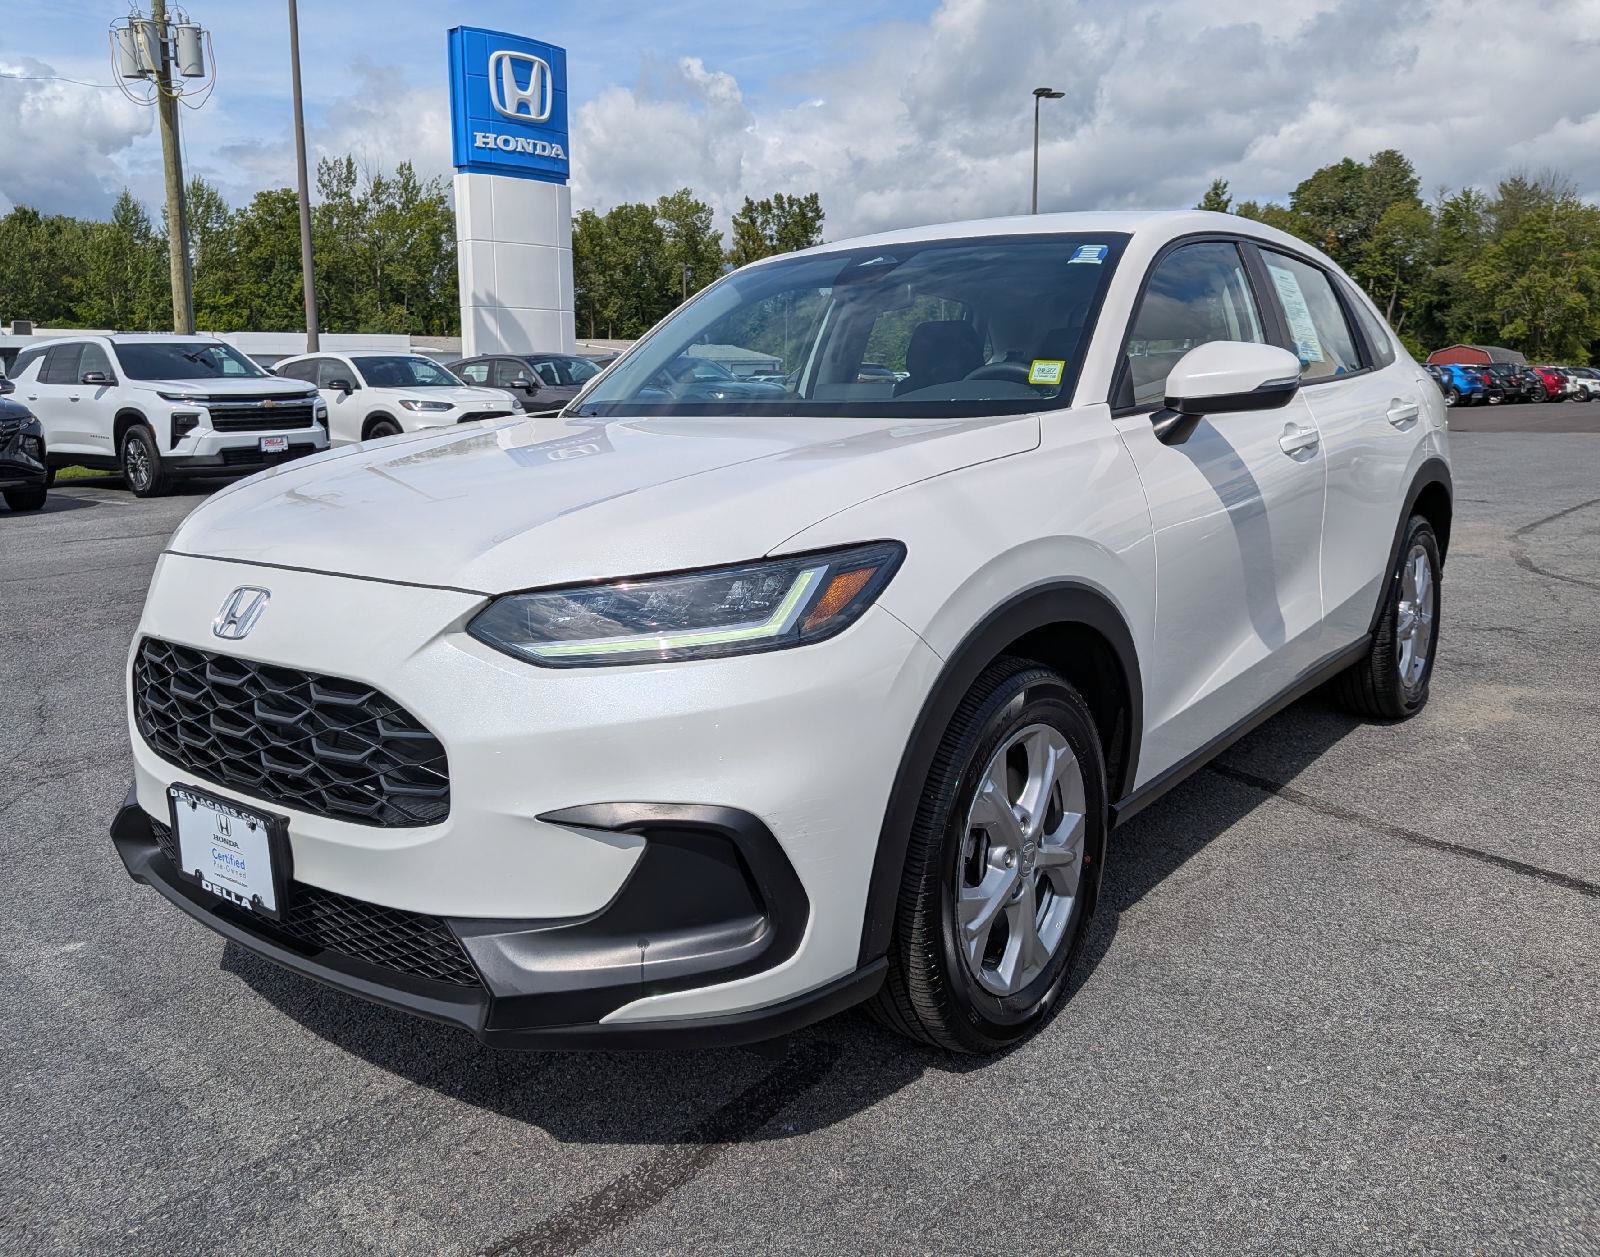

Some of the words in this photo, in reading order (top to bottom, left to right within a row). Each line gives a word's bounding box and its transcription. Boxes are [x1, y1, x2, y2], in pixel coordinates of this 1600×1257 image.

[473, 132, 567, 160] HONDA
[170, 788, 265, 832] DELLACARS.COM
[212, 833, 240, 849] HONDA
[211, 847, 246, 870] Certified
[201, 879, 253, 911] DELLA
